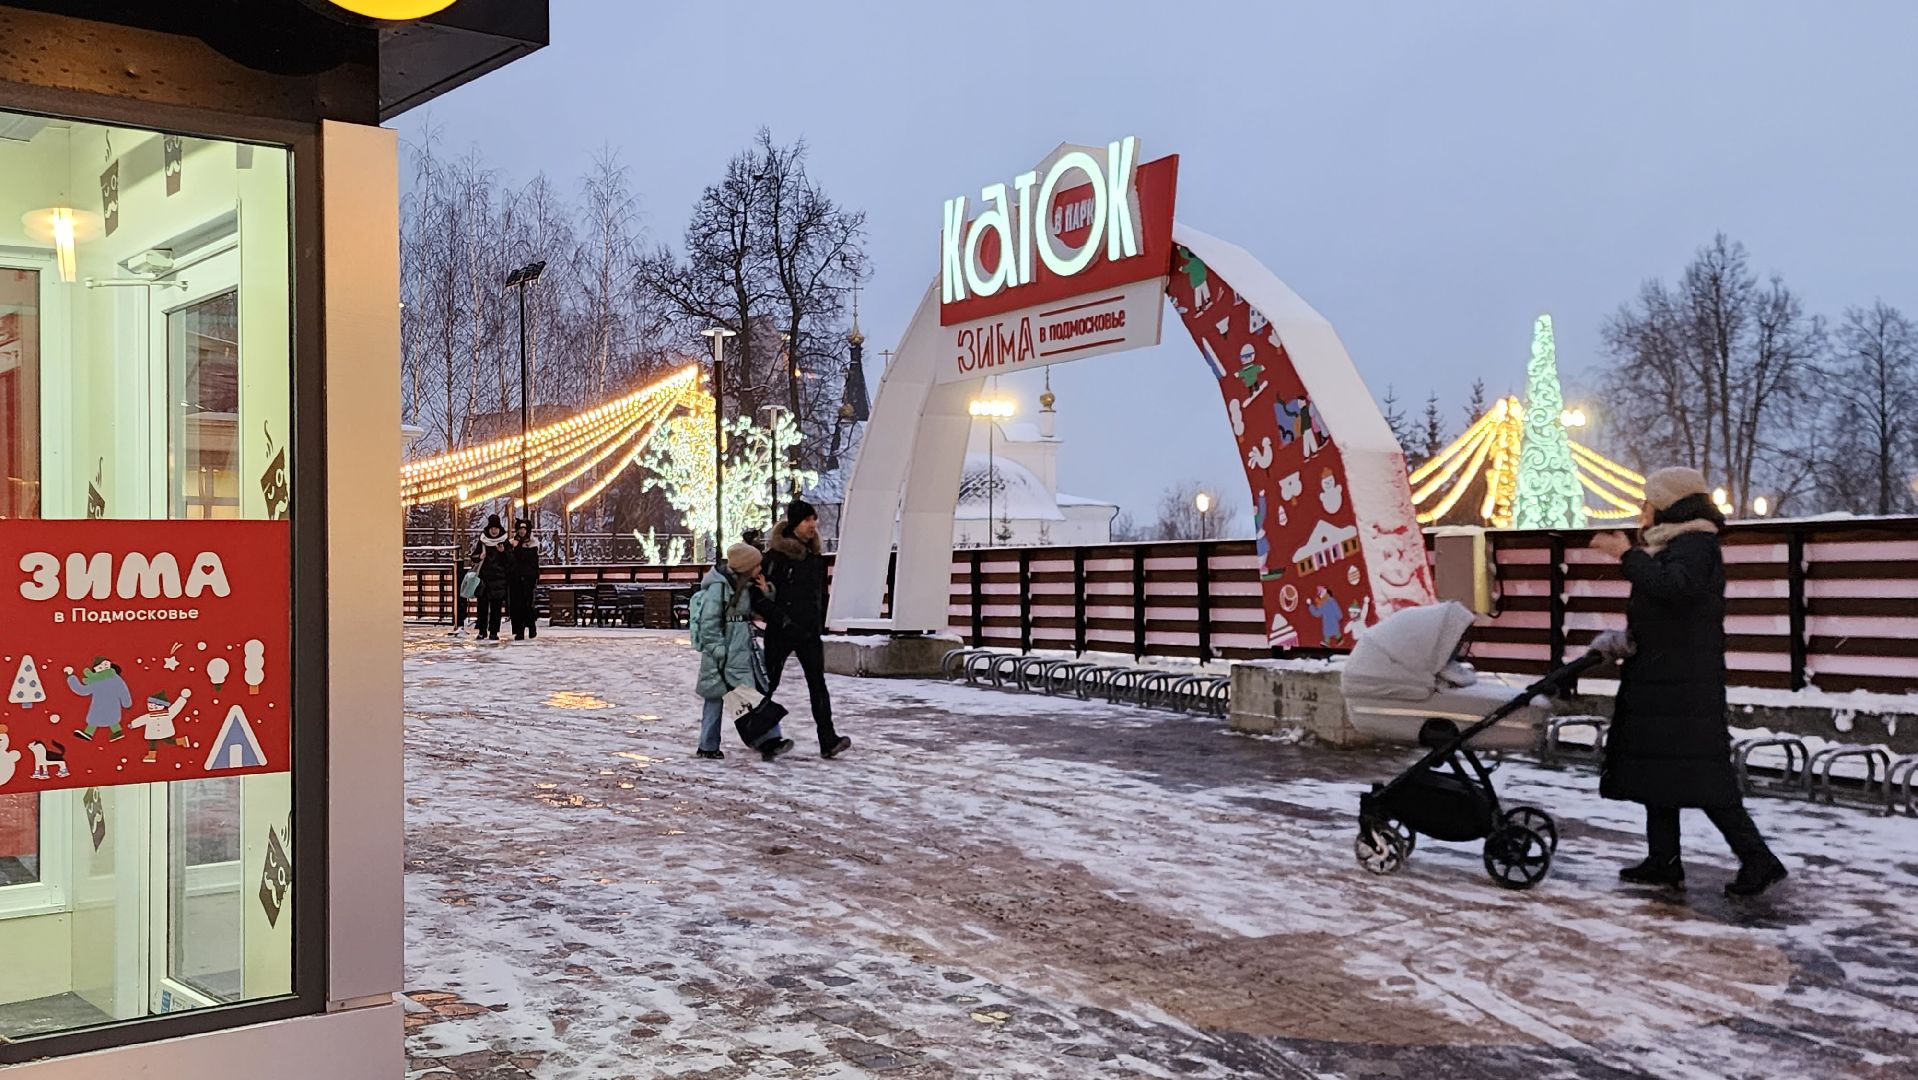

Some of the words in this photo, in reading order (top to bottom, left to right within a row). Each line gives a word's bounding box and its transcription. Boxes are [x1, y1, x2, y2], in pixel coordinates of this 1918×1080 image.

[1065, 198, 1095, 232] ПАРК
[957, 316, 1036, 374] ЗИМА
[19, 551, 231, 601] ЗИМА
[54, 611, 65, 623] в
[72, 607, 199, 624] Подмосковье
